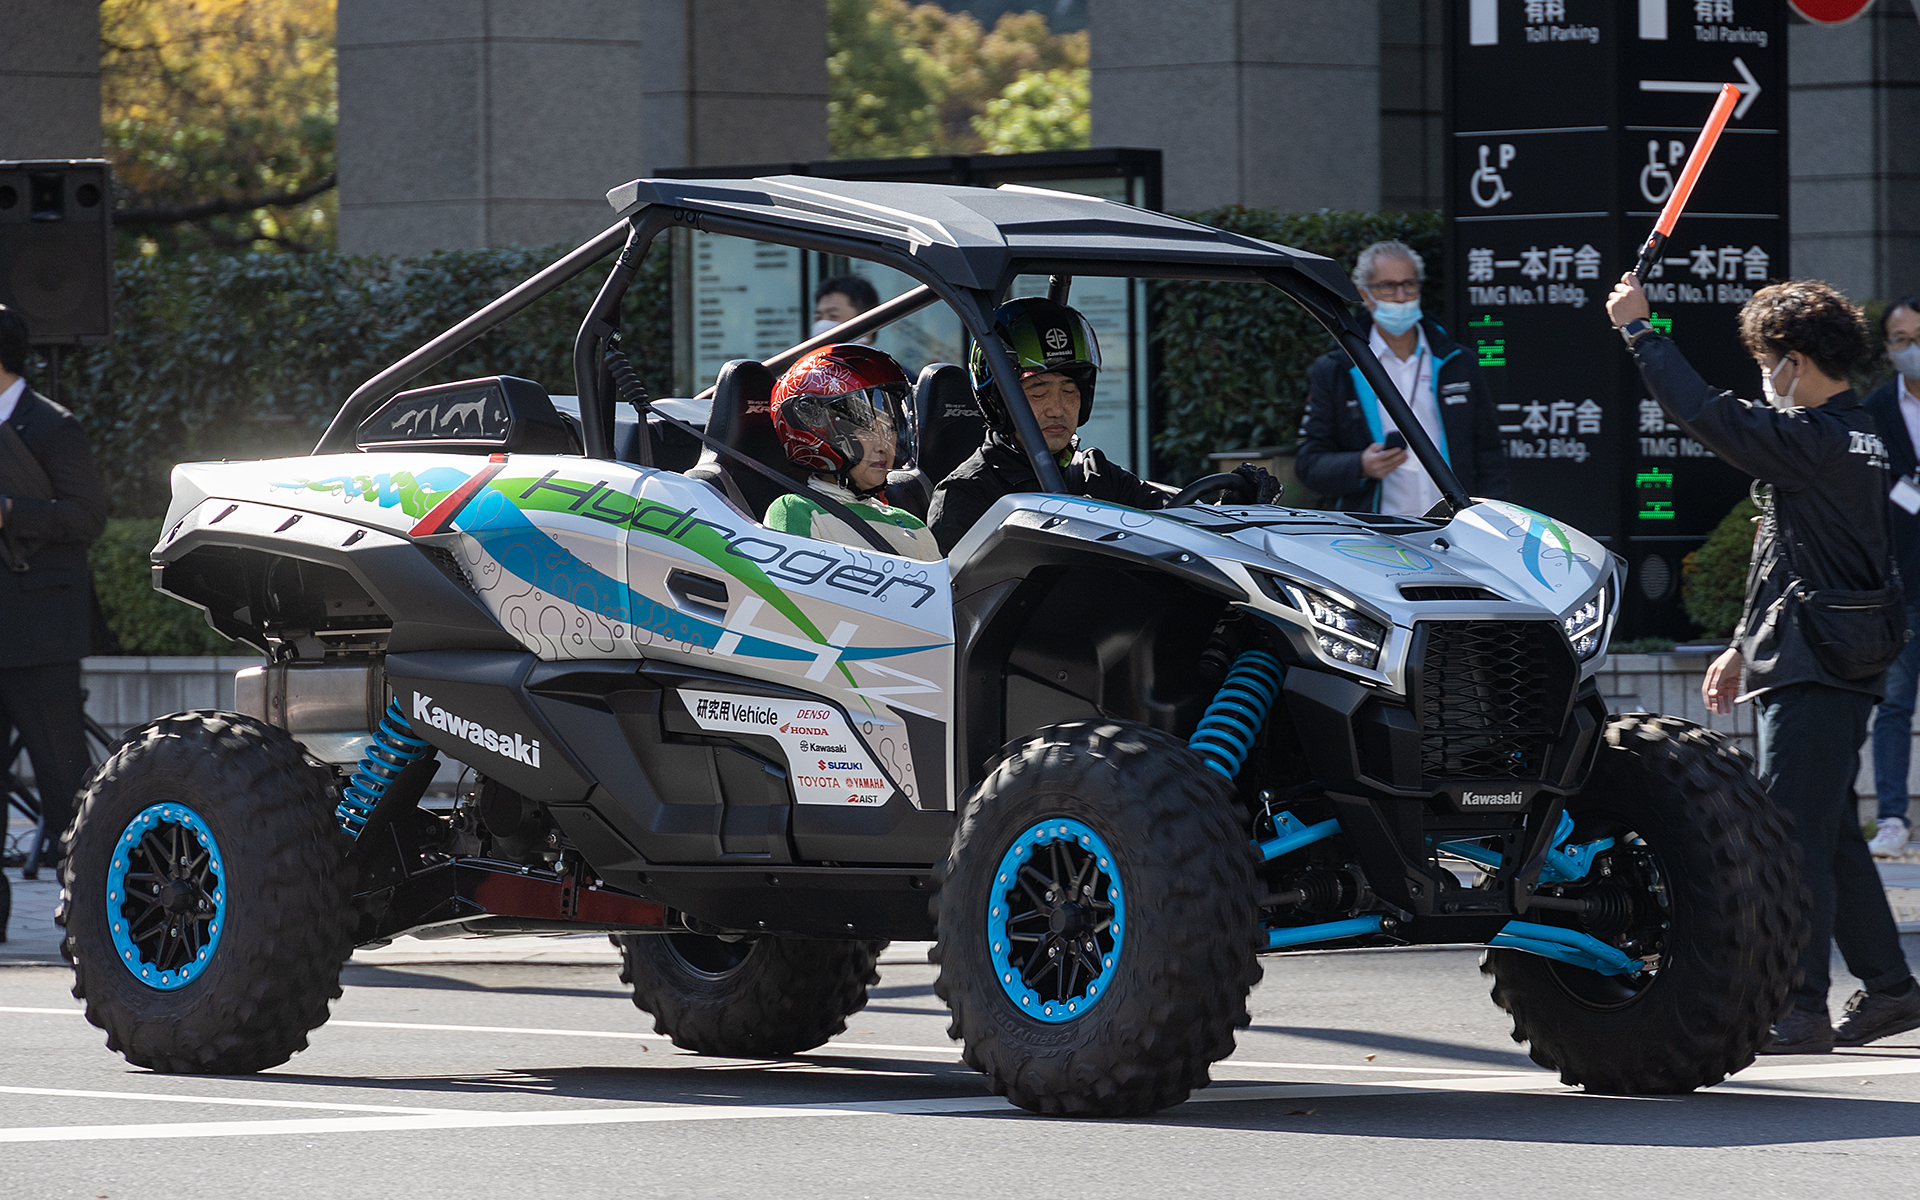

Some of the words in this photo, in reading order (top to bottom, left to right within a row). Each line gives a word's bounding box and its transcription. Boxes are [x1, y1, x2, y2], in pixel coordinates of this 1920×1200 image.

[1524, 26, 1549, 42] Toll
[1551, 24, 1599, 44] Parking
[1694, 25, 1718, 42] Toll
[1719, 26, 1768, 47] Parking
[1499, 143, 1516, 169] P
[1668, 140, 1686, 166] P
[1468, 244, 1601, 281] 第一本庁舎
[1469, 286, 1506, 305] TMG
[1508, 285, 1544, 304] No.1
[1549, 283, 1589, 308] Bldg.
[1678, 283, 1715, 303] No.1
[1046, 349, 1073, 357] Kawasaki
[943, 408, 982, 417] KRX
[1510, 438, 1547, 458] No.2
[1550, 438, 1590, 462] Bldg.
[1639, 437, 1677, 457] TMG
[1680, 438, 1716, 457] No.
[518, 470, 936, 609] Hydrogen
[796, 709, 831, 720] DENSO
[413, 690, 541, 769] Kawasaki
[790, 726, 830, 736] HONDA
[809, 743, 847, 753] Kawasaki
[827, 761, 863, 771] SUZUKI
[797, 775, 841, 789] TOYOTA
[854, 778, 885, 789] YAMAHA
[859, 795, 878, 804] AIST
[1462, 791, 1523, 805] Kawasaki
